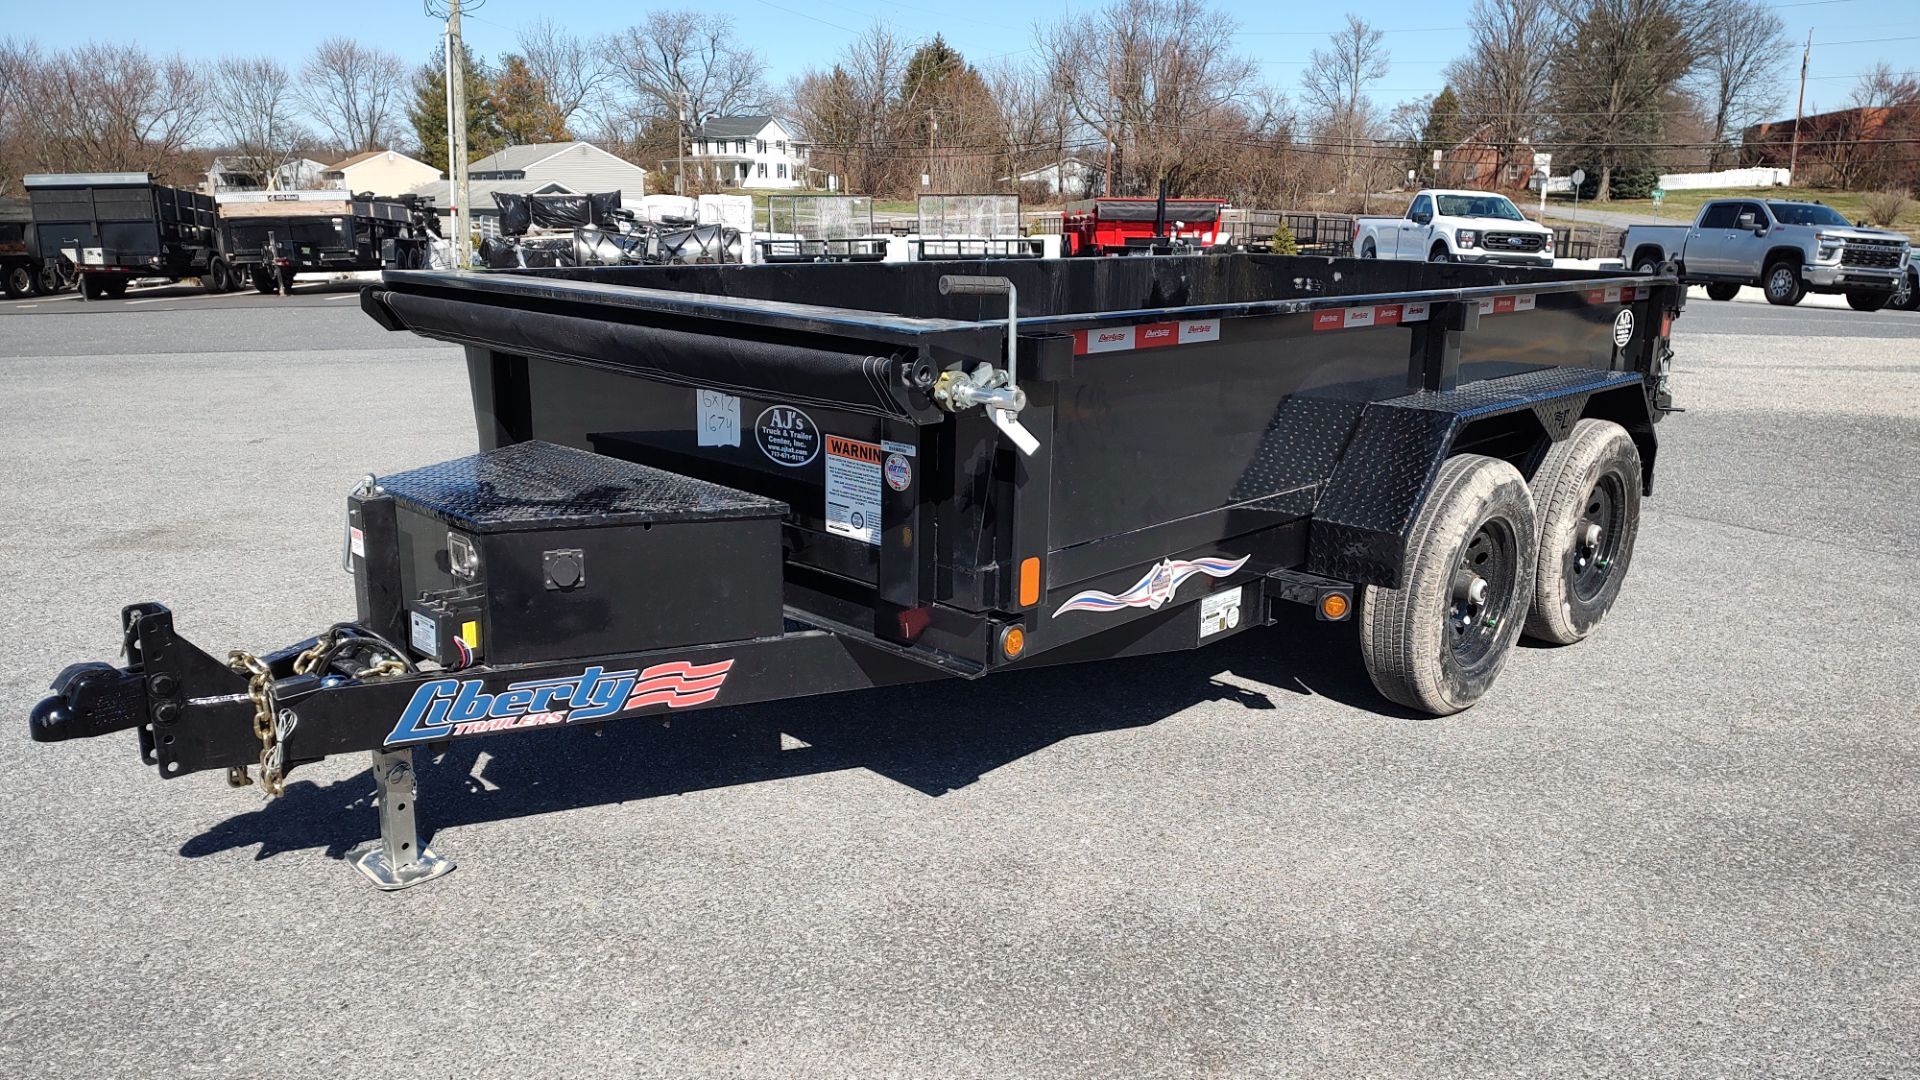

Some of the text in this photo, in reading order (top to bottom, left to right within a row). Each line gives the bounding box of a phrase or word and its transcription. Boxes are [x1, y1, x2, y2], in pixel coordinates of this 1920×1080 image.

[705, 412, 733, 441] 1674
[770, 409, 804, 430] AJ's
[761, 425, 781, 436] Truck
[790, 430, 812, 441] Trailer
[768, 435, 807, 448] Center, Inc.
[830, 439, 881, 463] WARNIN
[383, 665, 640, 746] Liberty
[452, 710, 568, 736] TRAILERS
